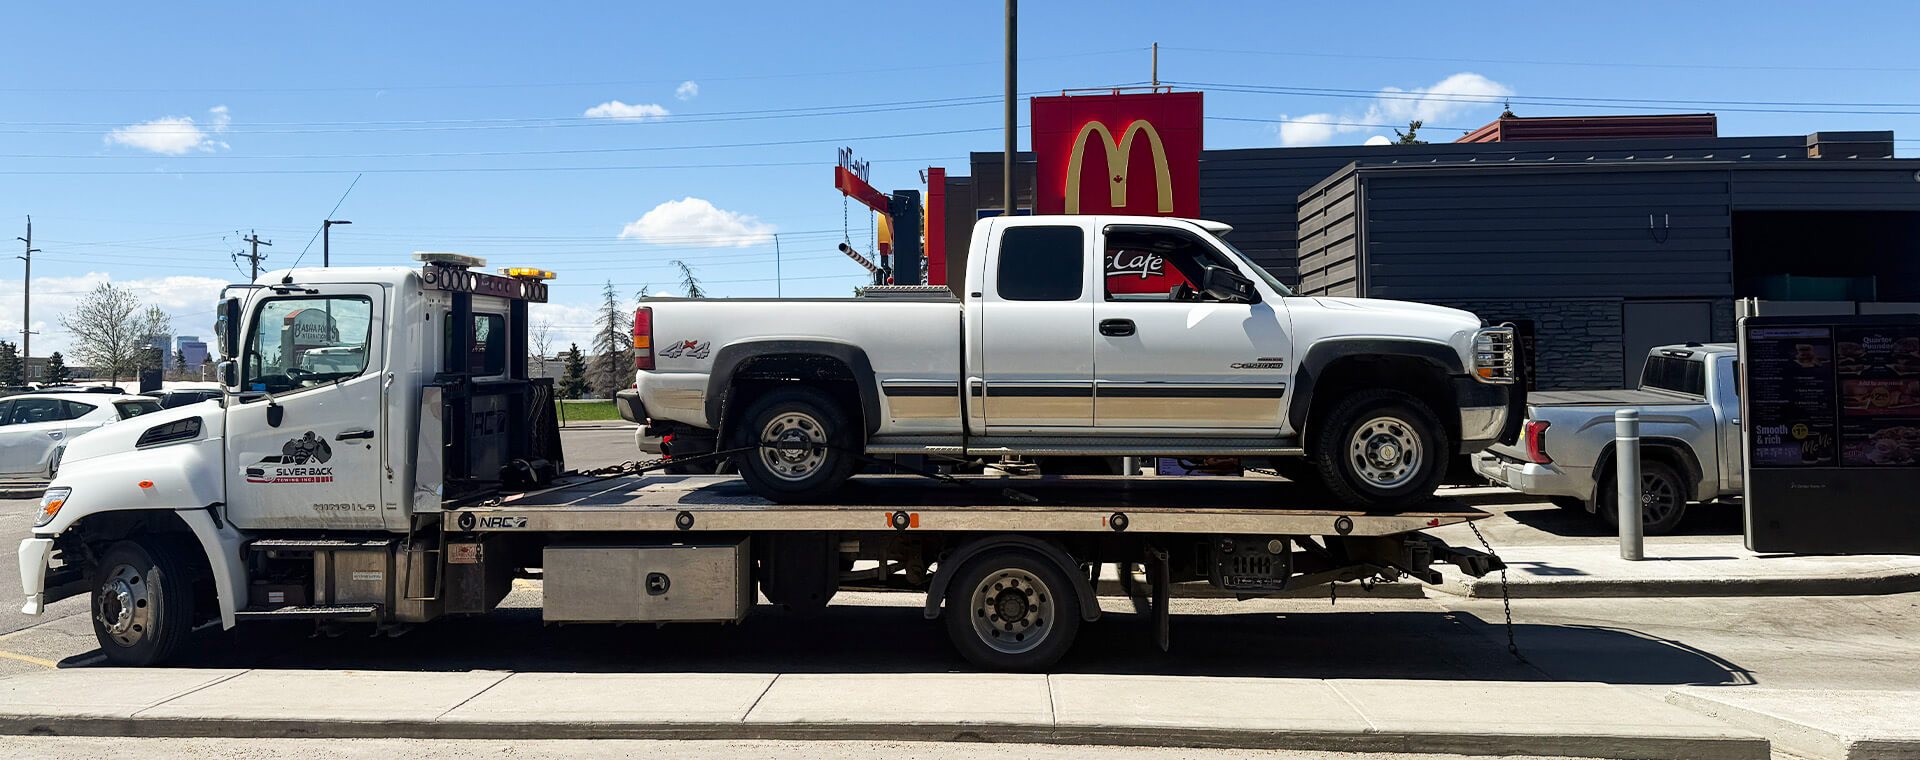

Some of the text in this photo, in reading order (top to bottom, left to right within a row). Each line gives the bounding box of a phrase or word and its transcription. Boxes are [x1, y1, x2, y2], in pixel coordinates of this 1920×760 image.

[1755, 424, 1788, 436] Smooth
[1756, 434, 1781, 445] & rich
[276, 467, 333, 476] SILVER BACK
[480, 516, 514, 528] NRC
